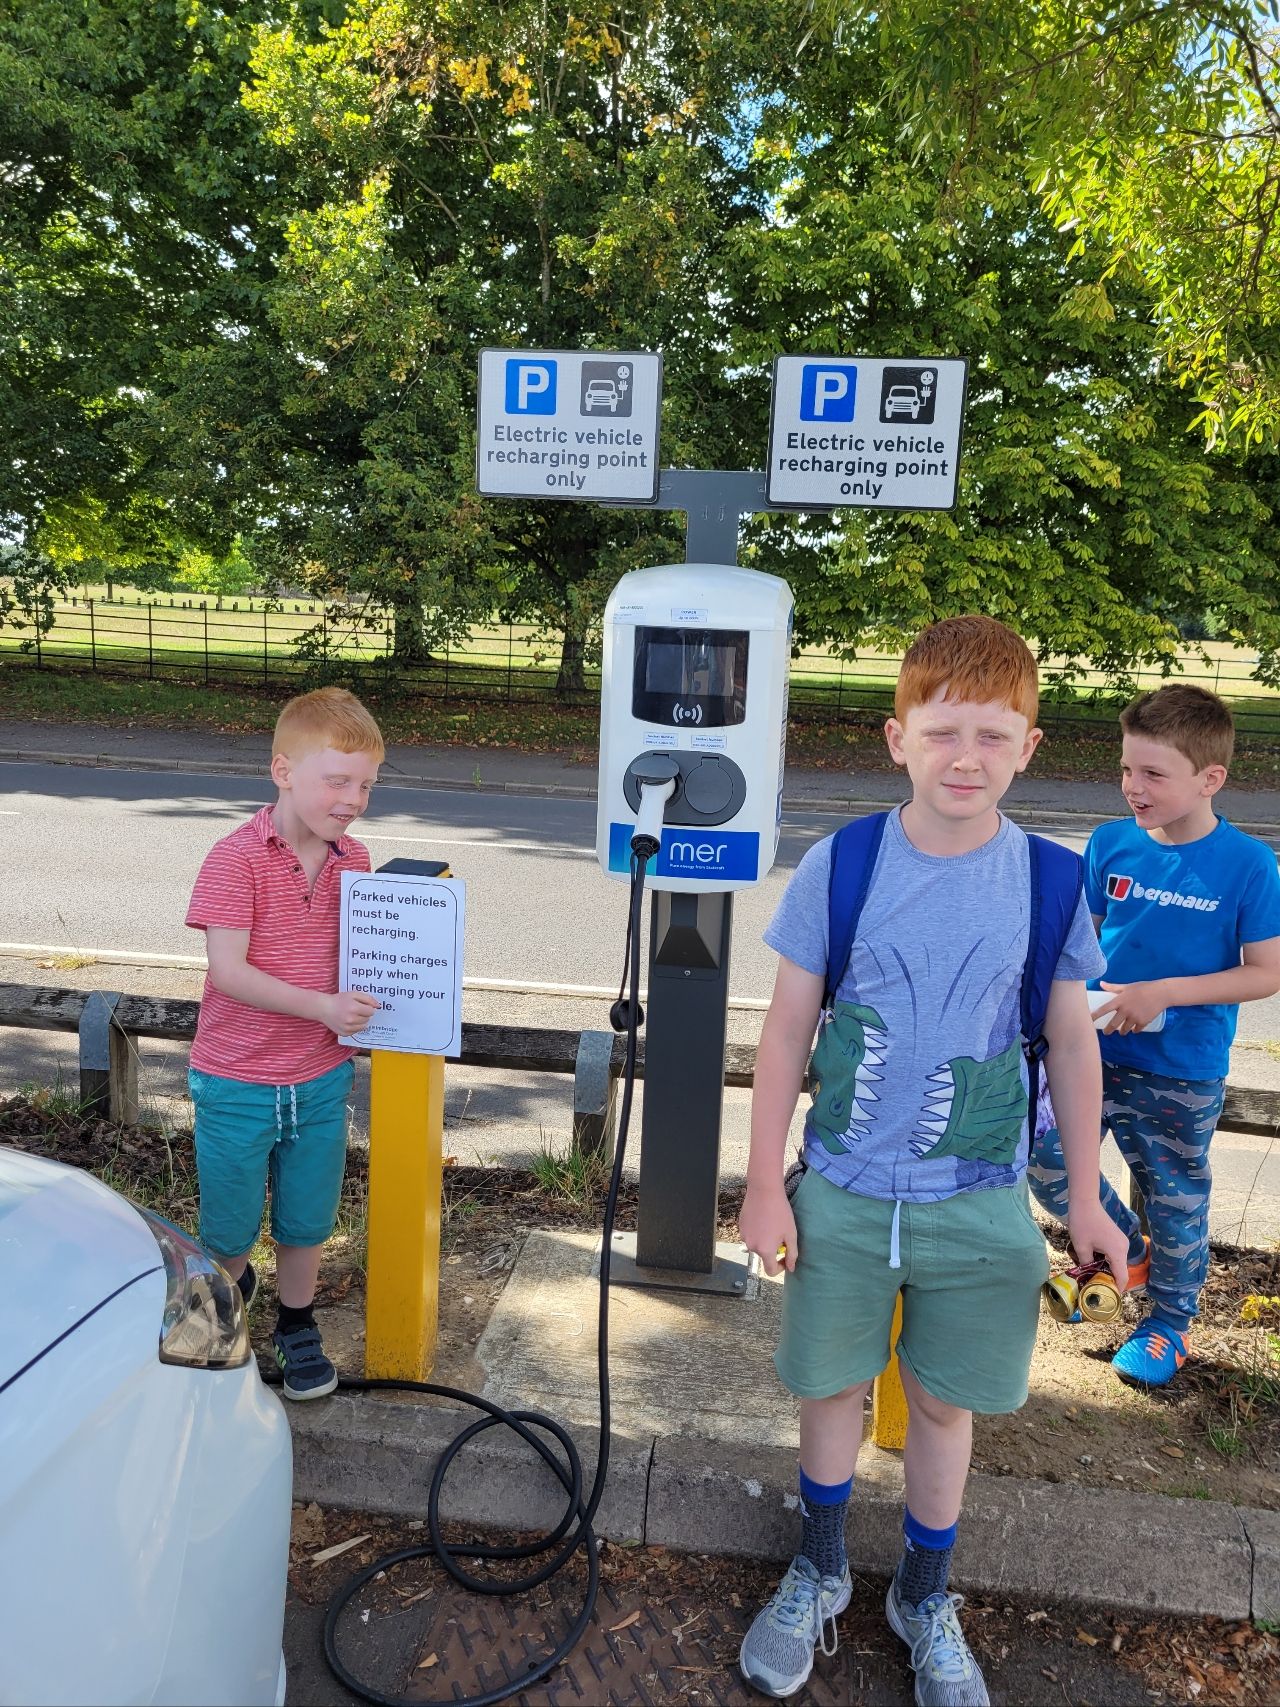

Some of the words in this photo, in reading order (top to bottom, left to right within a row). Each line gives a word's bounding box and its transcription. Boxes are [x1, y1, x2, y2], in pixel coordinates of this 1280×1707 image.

[518, 365, 549, 410] P
[814, 372, 848, 416] P
[494, 425, 568, 444] Electric
[575, 428, 643, 446] vehicle
[787, 432, 865, 451] Electric
[873, 436, 945, 453] vehicle
[487, 448, 590, 469] recharging
[597, 451, 647, 469] point
[779, 456, 887, 477] recharging
[895, 459, 949, 477] point
[546, 471, 586, 490] only
[840, 480, 883, 499] only
[669, 841, 728, 863] mer
[352, 890, 394, 903] Parked
[398, 895, 447, 908] vehicles
[1132, 882, 1220, 912] berghaus
[352, 909, 382, 919] must
[385, 910, 400, 920] be
[352, 925, 419, 941] recharging.
[351, 949, 396, 965] Parking
[400, 954, 448, 967] charges
[351, 966, 383, 979] apply
[387, 970, 418, 981] when
[351, 983, 414, 999] recharging
[418, 990, 445, 1000] your
